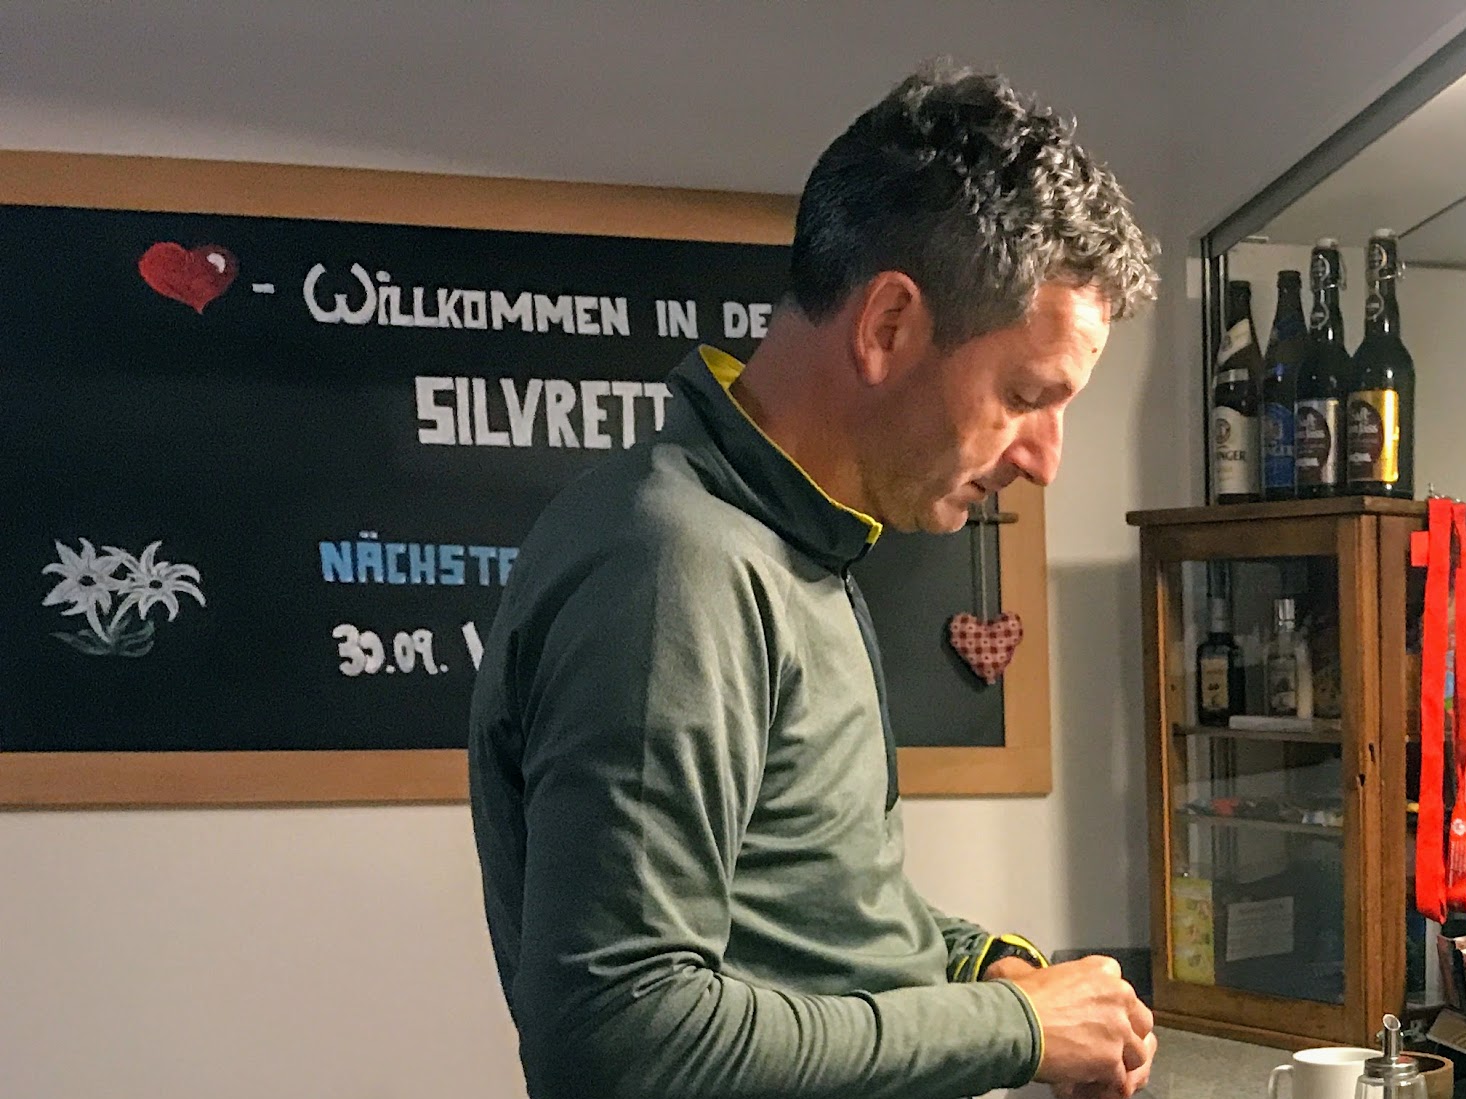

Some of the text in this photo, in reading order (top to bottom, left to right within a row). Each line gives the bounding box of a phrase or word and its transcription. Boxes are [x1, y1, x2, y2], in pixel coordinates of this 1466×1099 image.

[656, 300, 698, 339] IN
[724, 302, 773, 339] DE
[415, 376, 674, 450] SILVRETT
